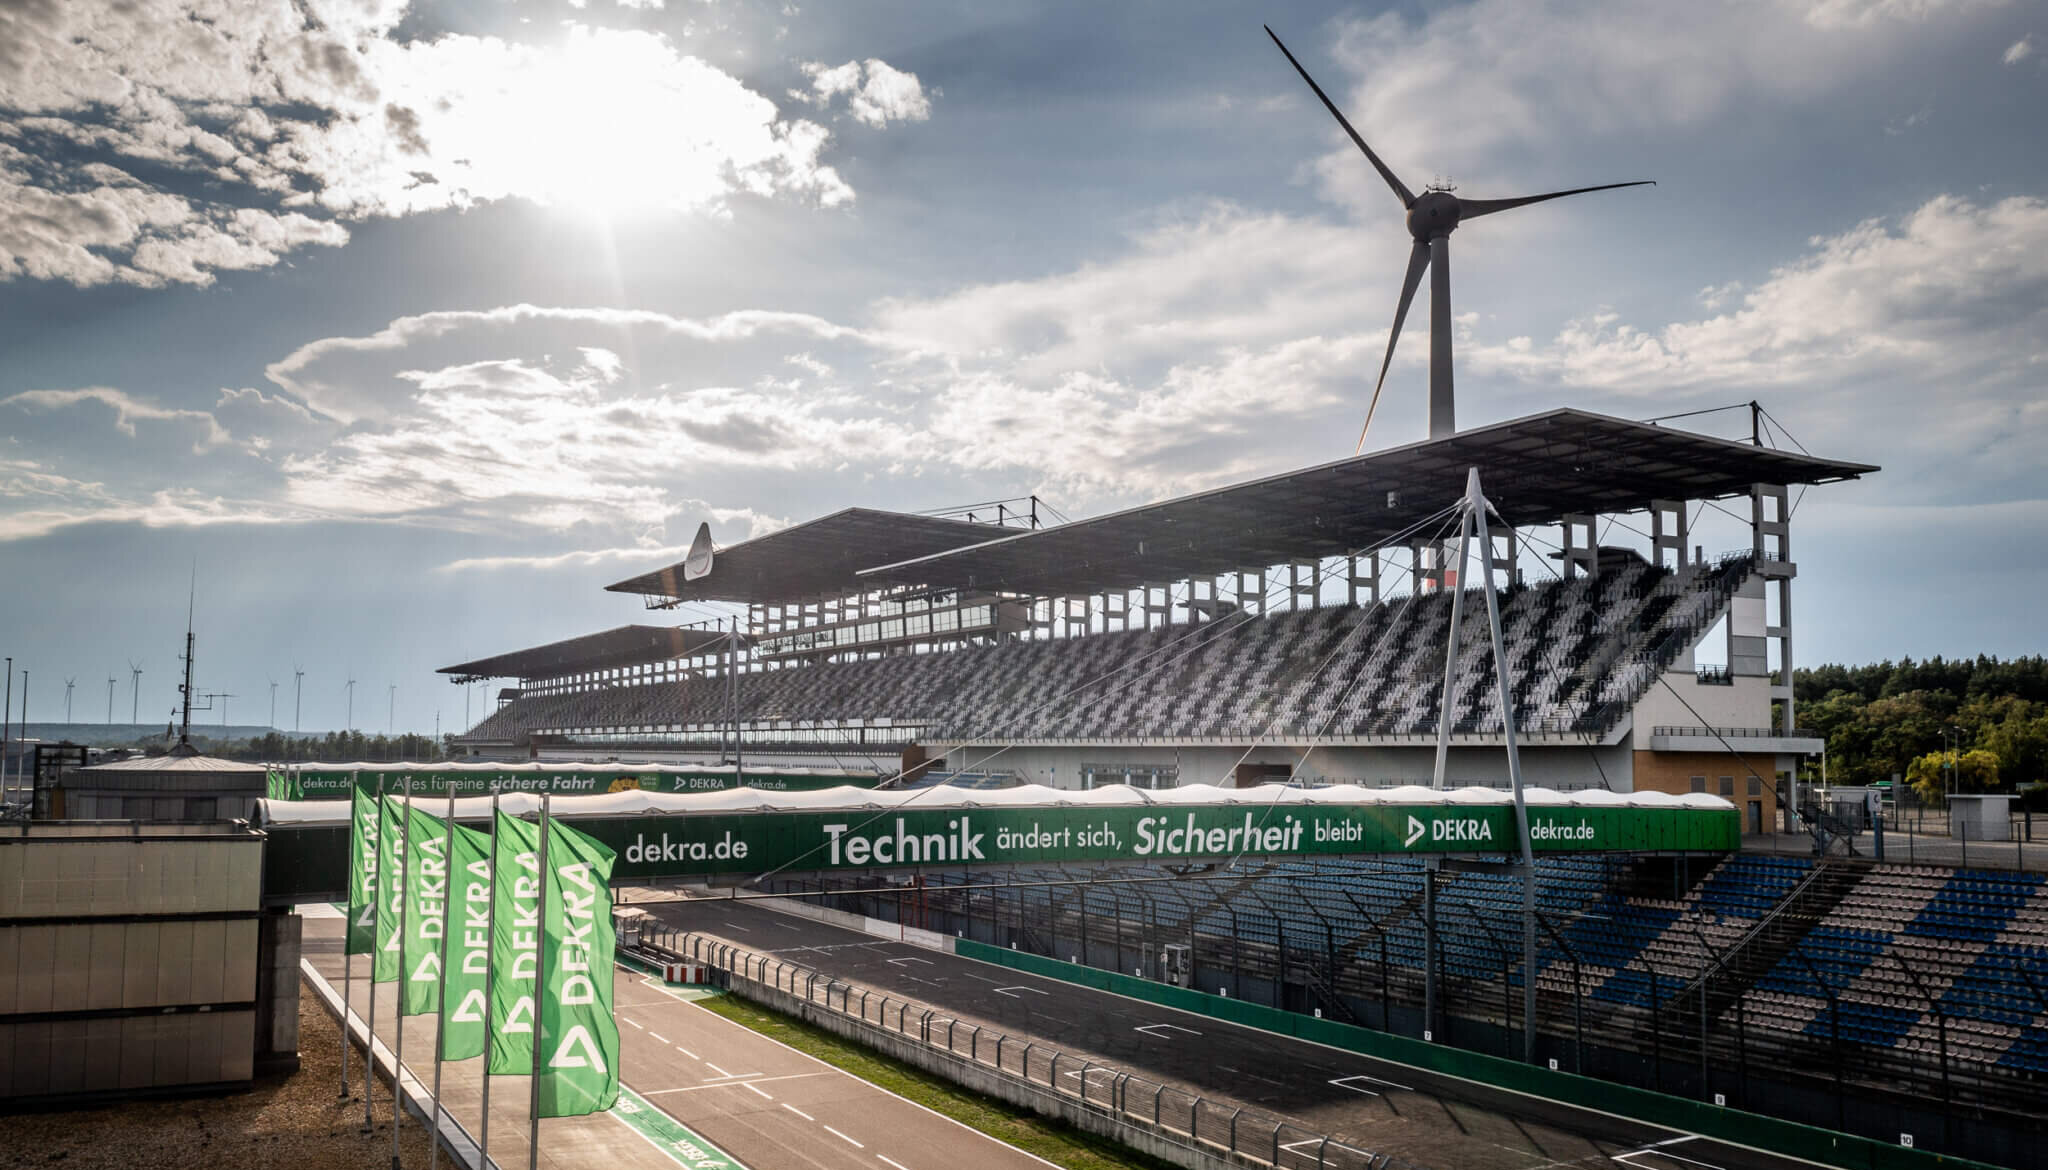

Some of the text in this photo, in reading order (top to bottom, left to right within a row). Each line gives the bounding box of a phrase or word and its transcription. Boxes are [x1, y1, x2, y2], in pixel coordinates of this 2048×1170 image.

[392, 776, 427, 790] Aes
[456, 777, 485, 790] eine
[489, 775, 548, 789] sichere
[552, 776, 596, 789] Fahrt
[690, 778, 725, 789] DEKRA
[747, 779, 787, 790] dekra.de
[823, 812, 1363, 865] Technik ändert sich, Sicherheit bleibt
[1433, 818, 1492, 841] DEKRA
[1530, 818, 1595, 840] dekra.de
[626, 831, 748, 864] dekra.de
[419, 836, 446, 939] DEKRA
[463, 858, 491, 974] DEKRA
[512, 850, 540, 979] DEKRA
[559, 861, 596, 1006] DEKRA
[1902, 1135, 1911, 1145] 10
